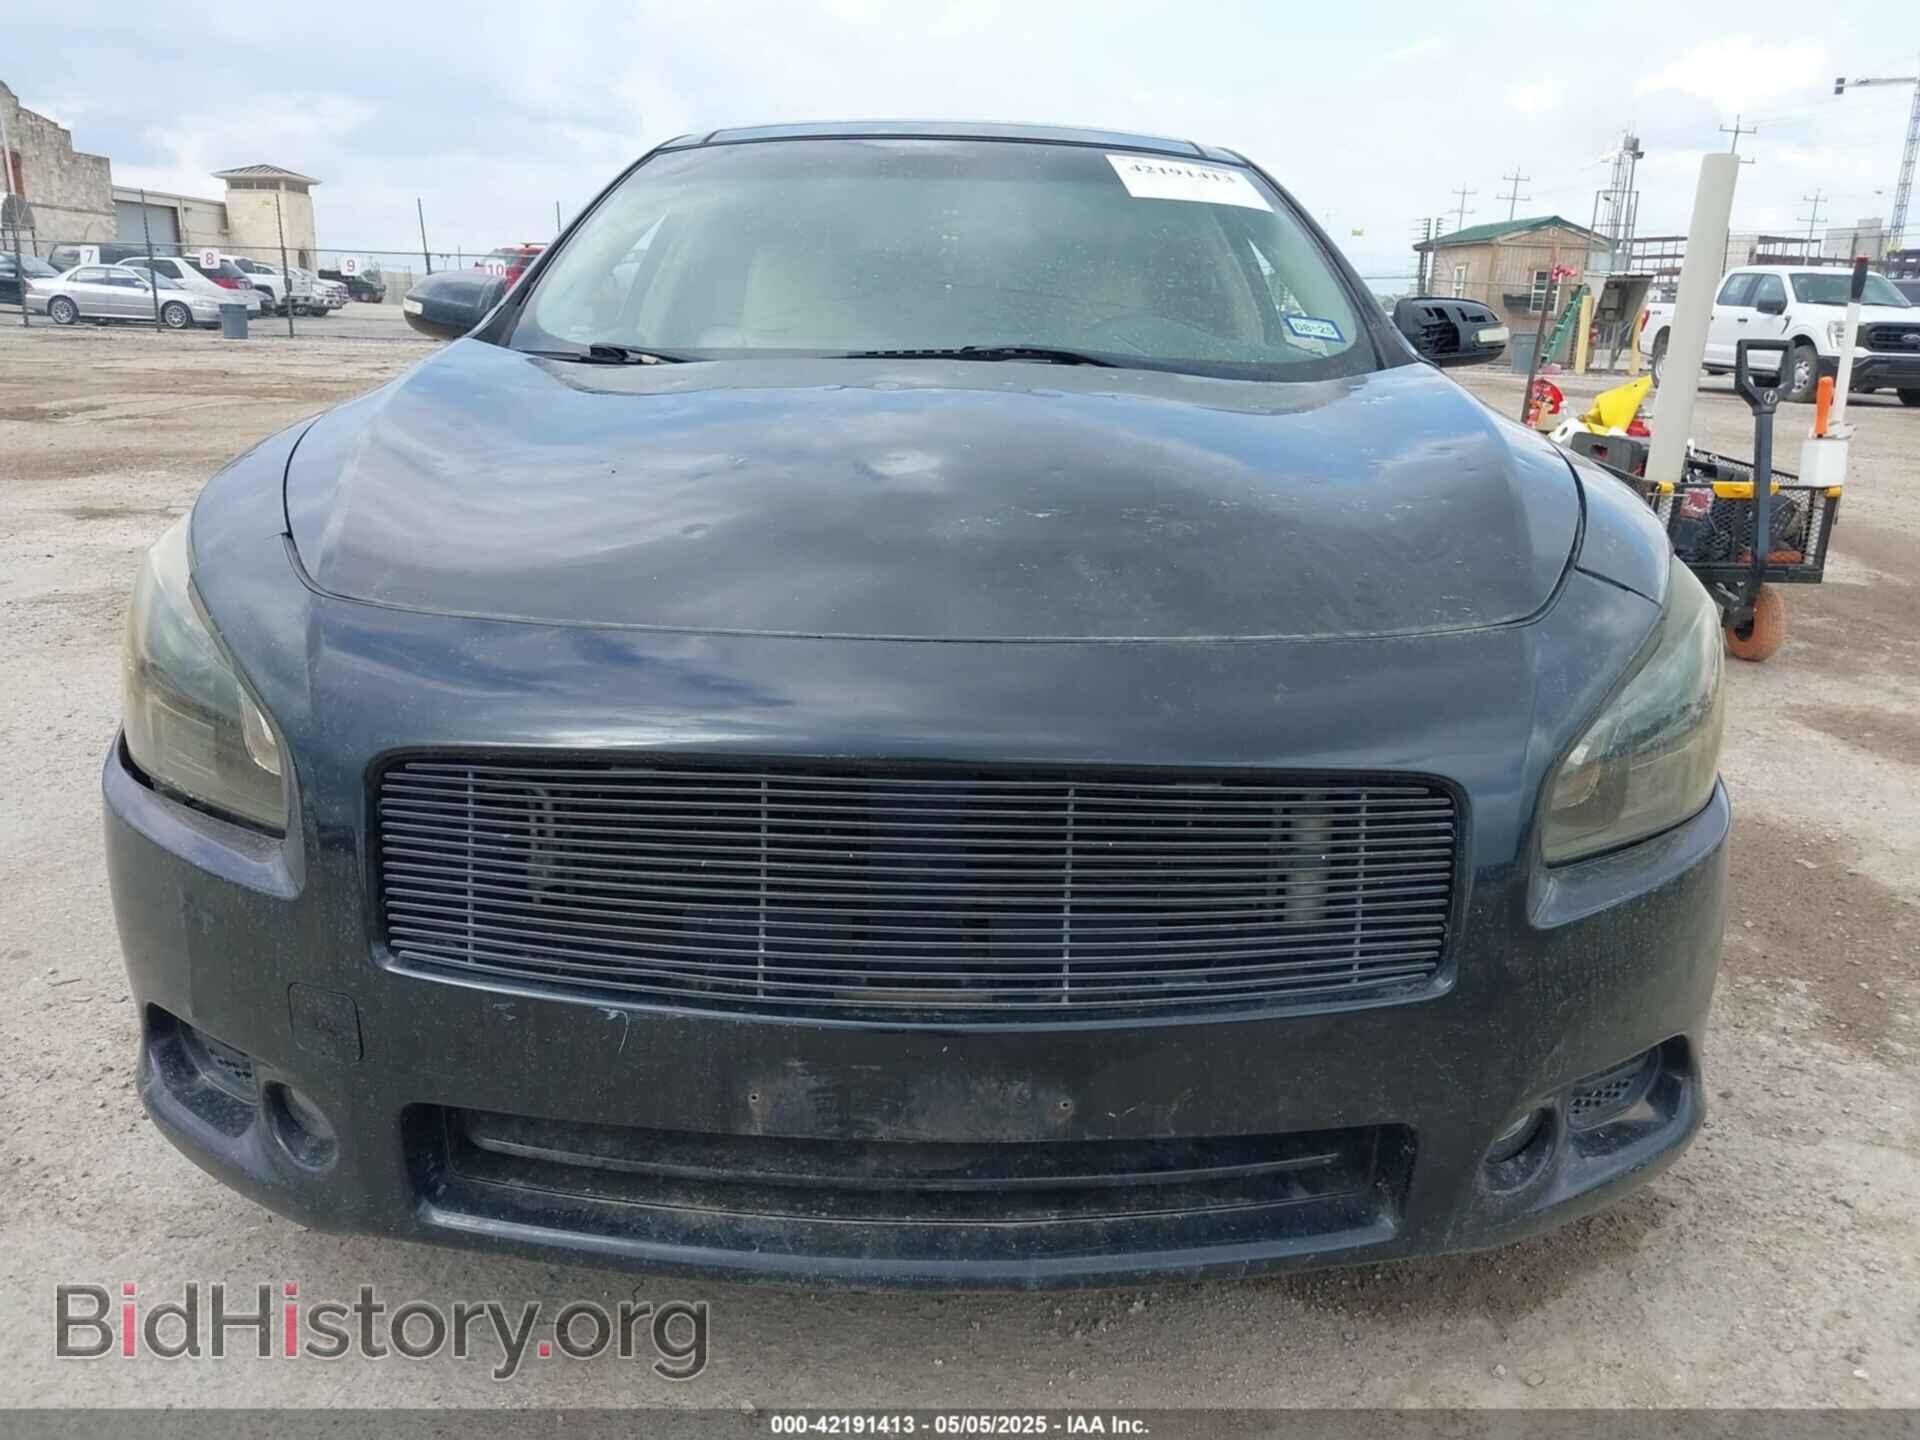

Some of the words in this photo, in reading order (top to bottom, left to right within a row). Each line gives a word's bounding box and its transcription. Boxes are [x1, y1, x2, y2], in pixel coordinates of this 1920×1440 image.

[84, 249, 95, 263] 7
[204, 252, 215, 266] 8
[345, 259, 356, 273] 9
